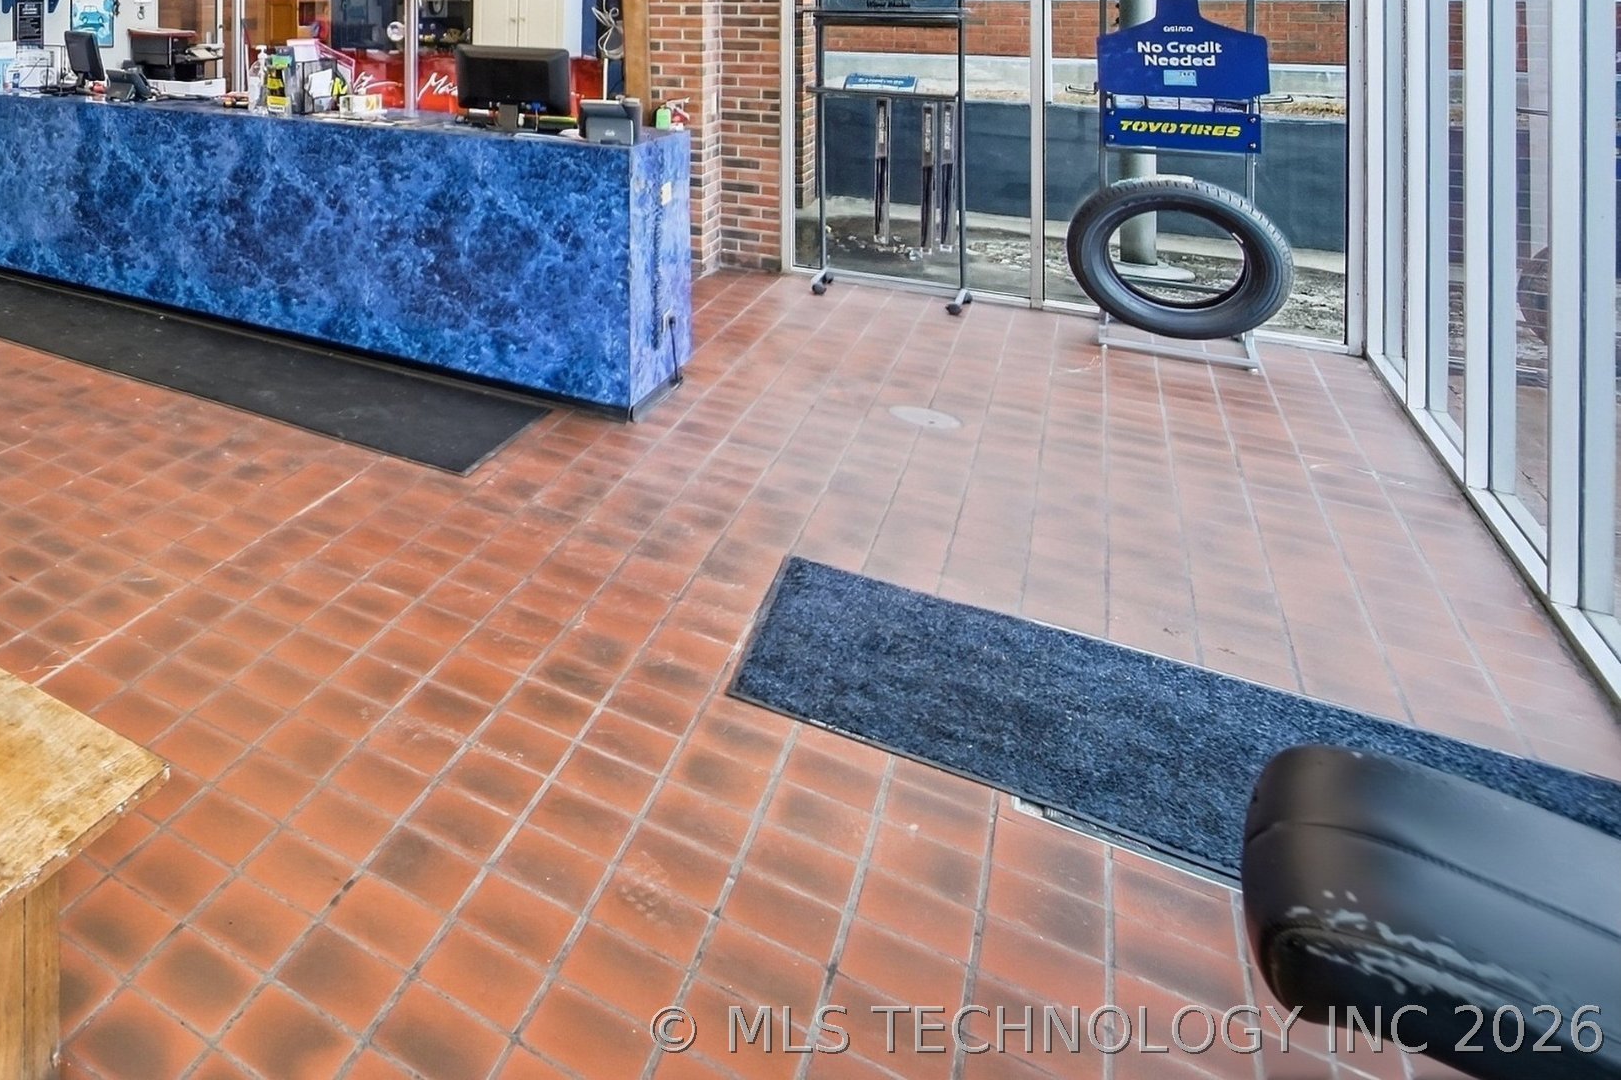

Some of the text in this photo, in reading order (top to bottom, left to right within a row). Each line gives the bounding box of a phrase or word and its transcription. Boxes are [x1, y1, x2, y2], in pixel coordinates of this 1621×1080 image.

[1136, 41, 1223, 54] No Credit
[1144, 54, 1216, 67] Needed
[1179, 123, 1242, 138] TIRES
